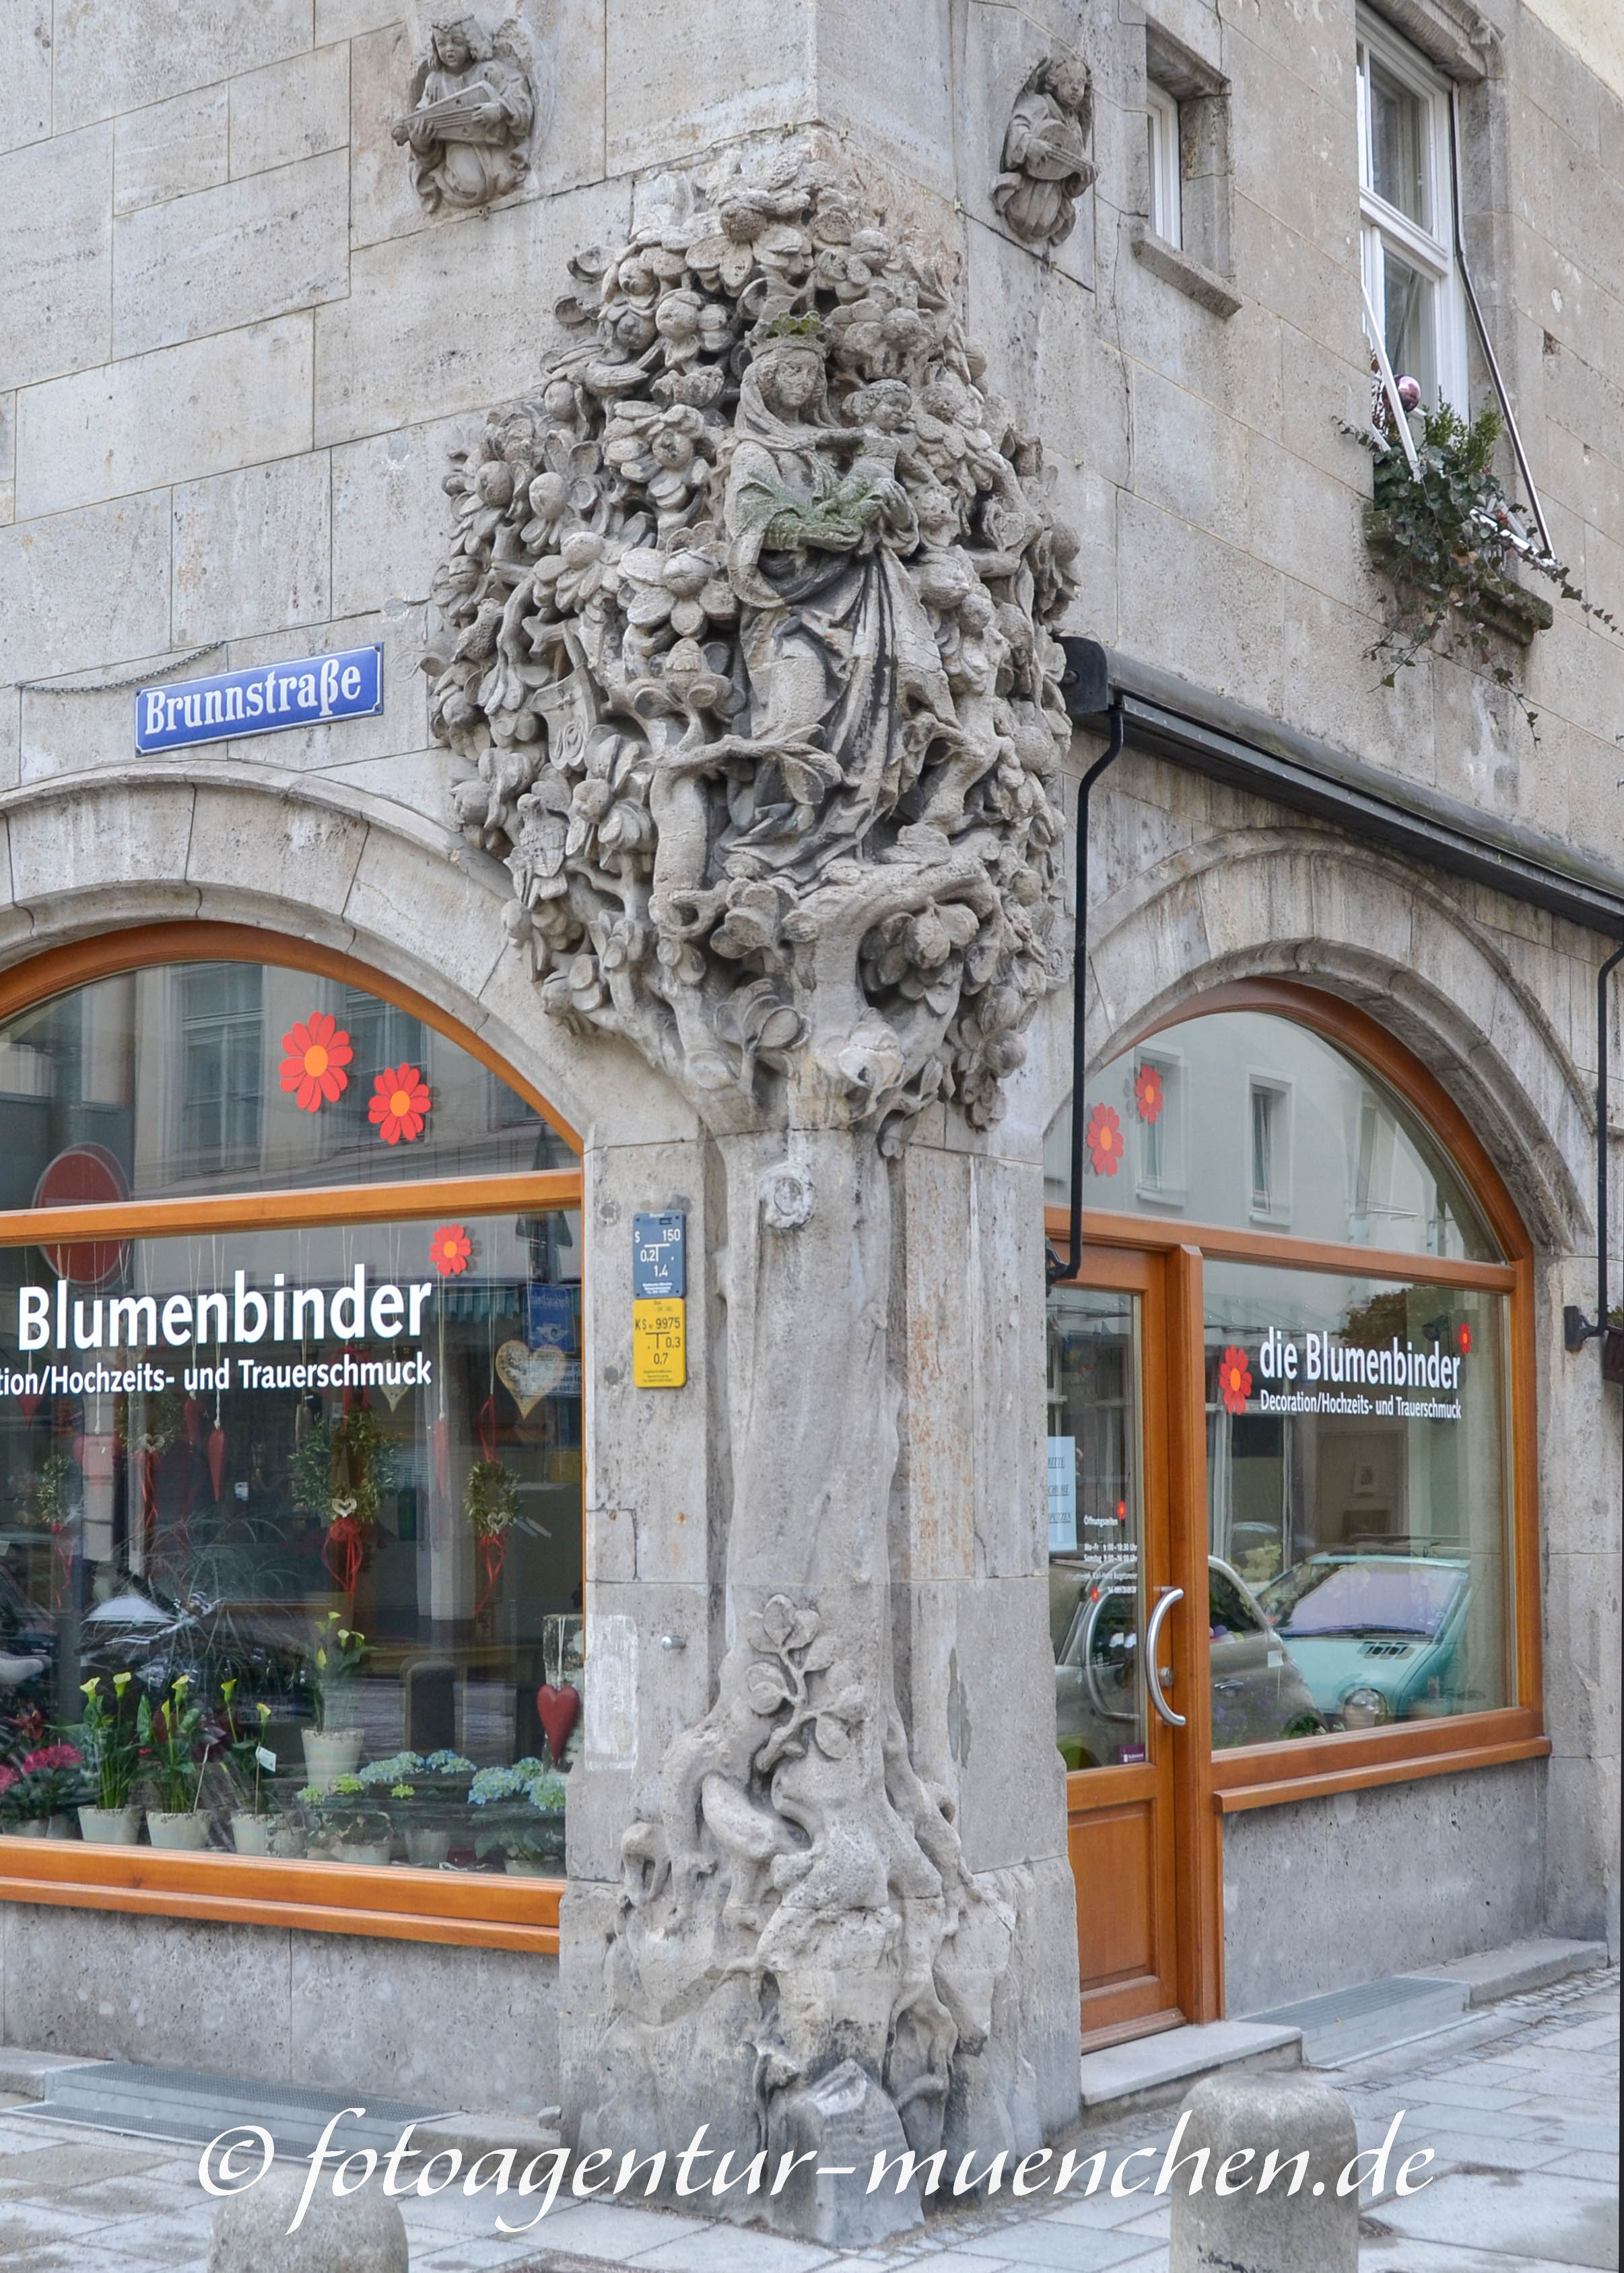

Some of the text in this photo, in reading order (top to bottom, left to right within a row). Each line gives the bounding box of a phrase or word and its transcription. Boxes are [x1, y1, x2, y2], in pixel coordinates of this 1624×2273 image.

[145, 658, 362, 735] Brunnstraße
[635, 1228, 681, 1243] S 150
[18, 1263, 432, 1351] Blumenbinder
[656, 1317, 681, 1330] 9975
[183, 1358, 230, 1390] und
[238, 1352, 432, 1389] Trauerschmuck
[1260, 1326, 1460, 1390] die Blumenbinder
[1260, 1390, 1462, 1419] Decoration/Hochzeits- und Trauerschmuck
[1130, 1542, 1138, 1551] Uhr
[1130, 1554, 1138, 1562] Uhr
